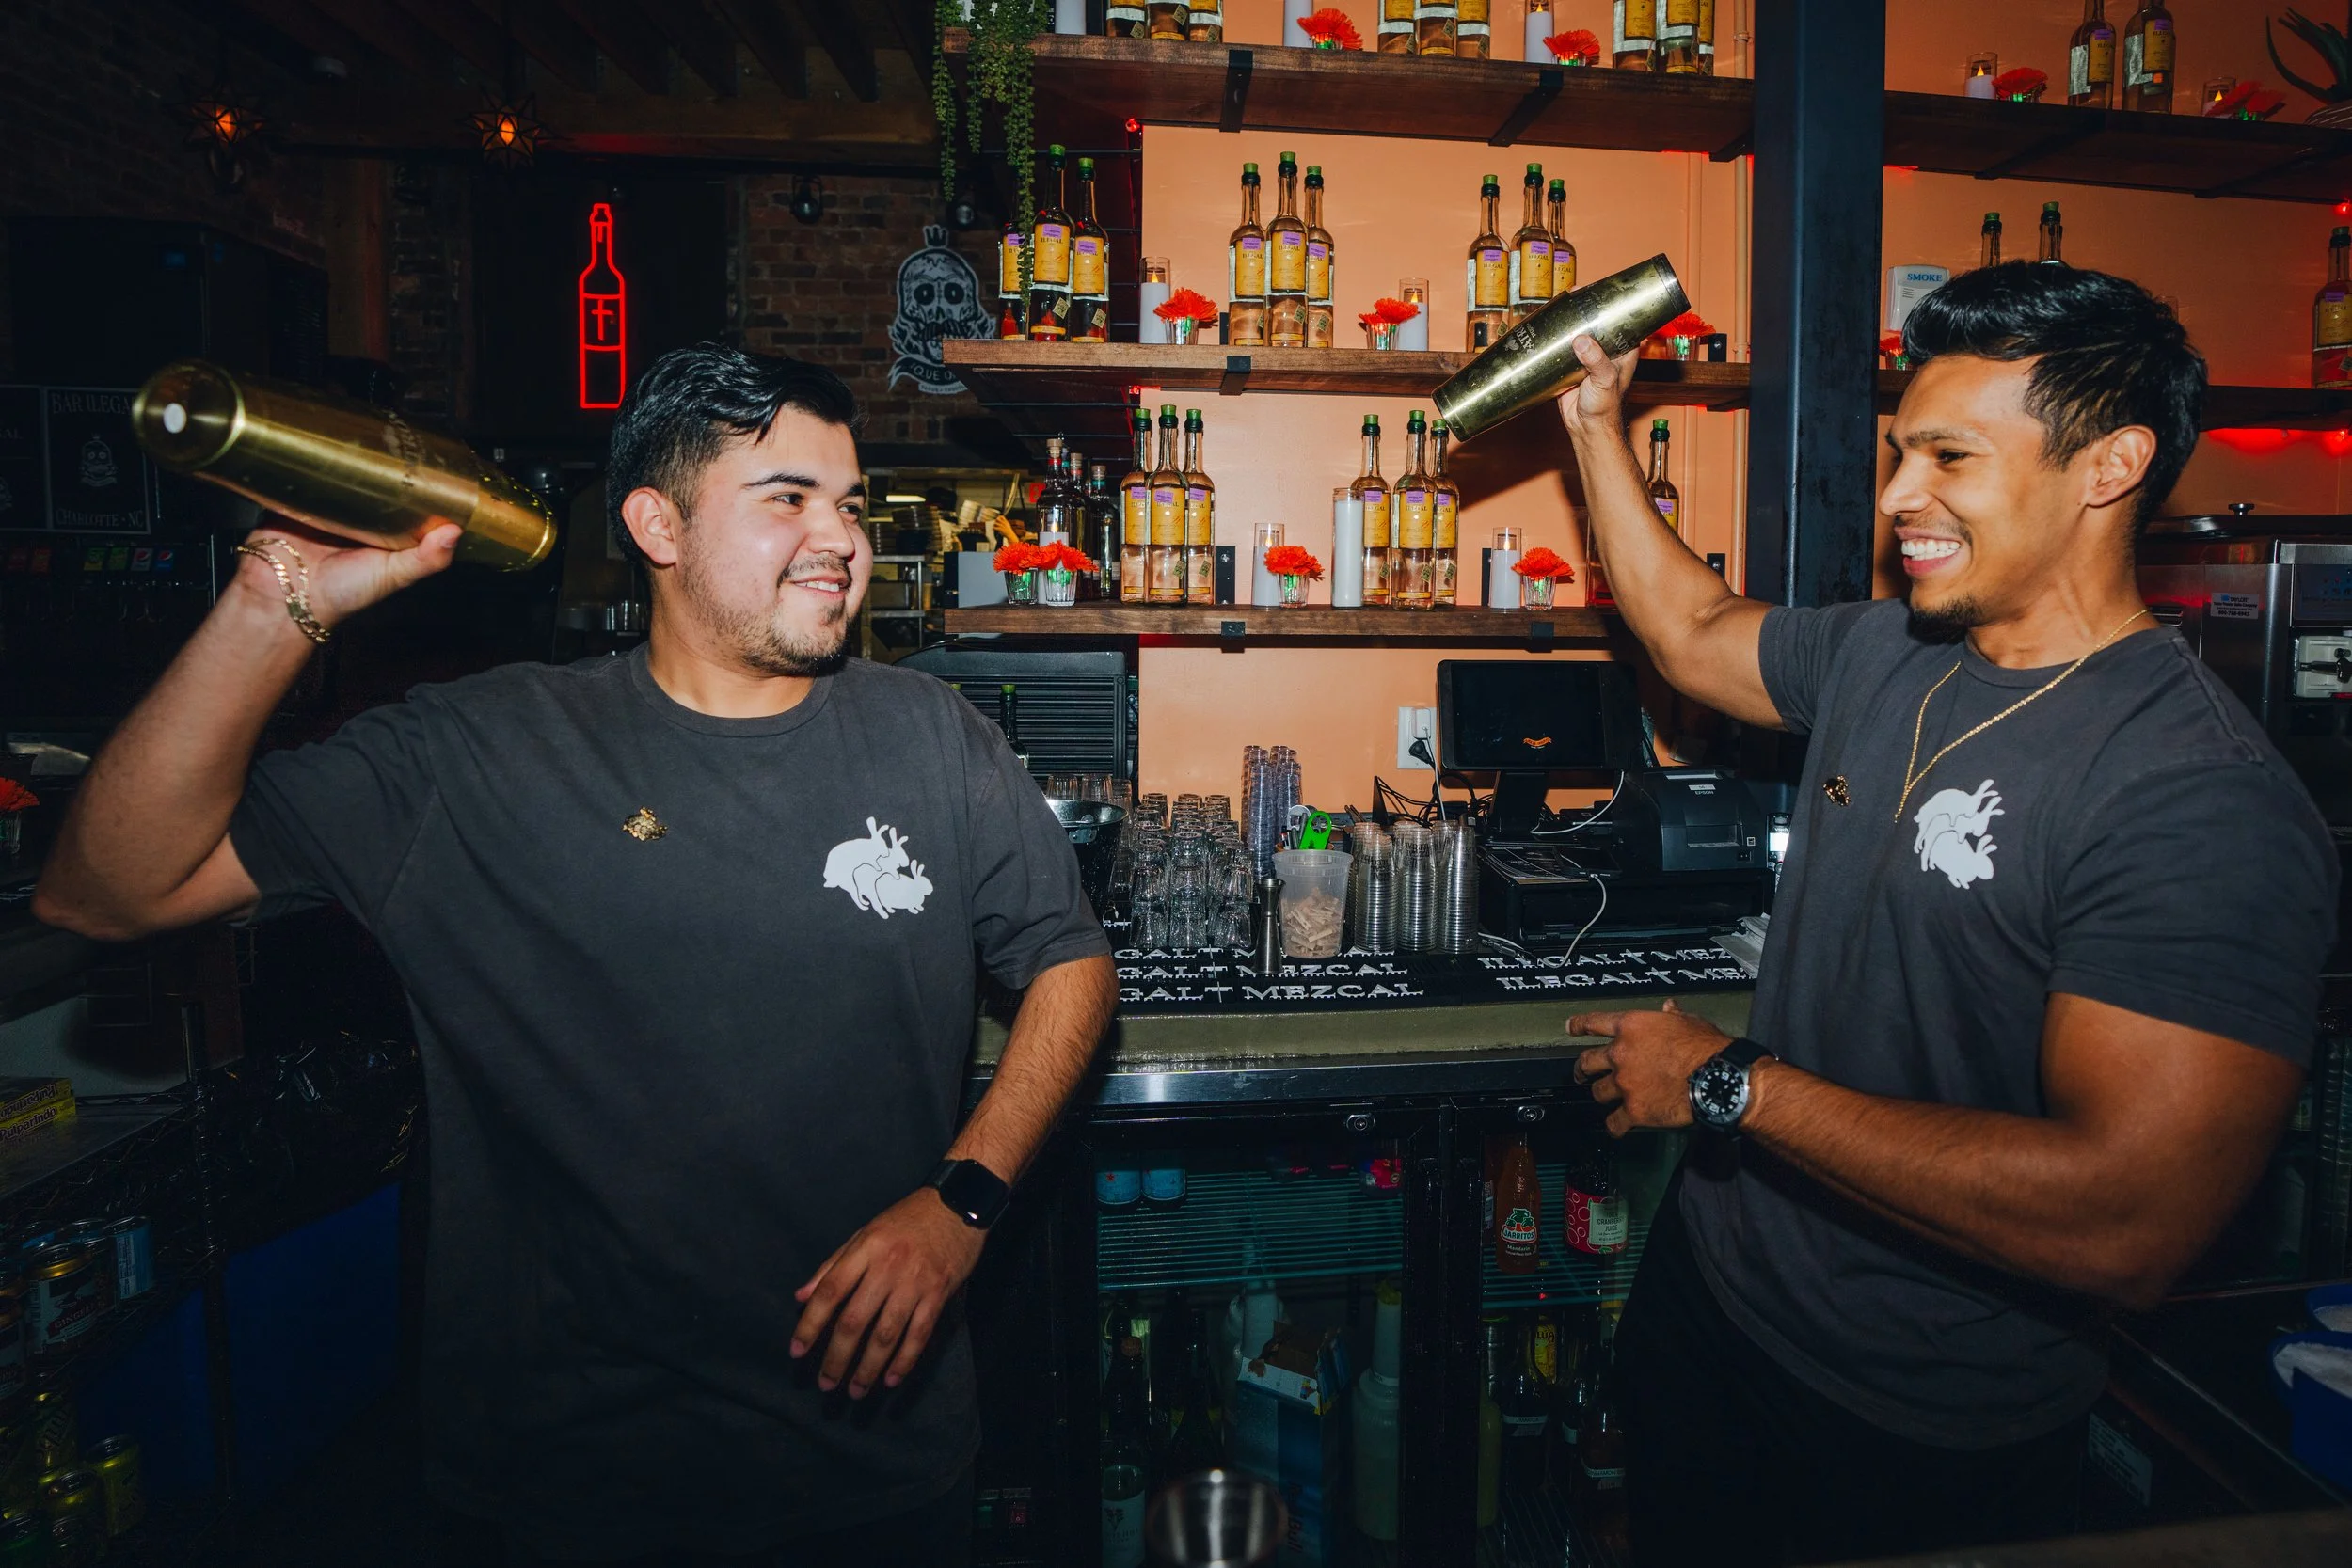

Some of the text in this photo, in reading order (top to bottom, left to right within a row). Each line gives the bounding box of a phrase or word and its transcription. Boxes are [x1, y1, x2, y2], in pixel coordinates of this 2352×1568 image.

[1907, 273, 1943, 282] SMOKE
[944, 370, 956, 380] O
[50, 391, 84, 415] BAR
[55, 508, 144, 528] CHARLOTTE NC
[1114, 948, 1198, 960] GAL
[1650, 947, 1733, 962] MEZ
[1116, 965, 1200, 980] GAL
[1496, 970, 1652, 990] ILEGAL
[1119, 982, 1424, 1002] GAL MEZCAL
[1503, 1228, 1534, 1241] JARRITOS
[1536, 1331, 1555, 1342] LUA
